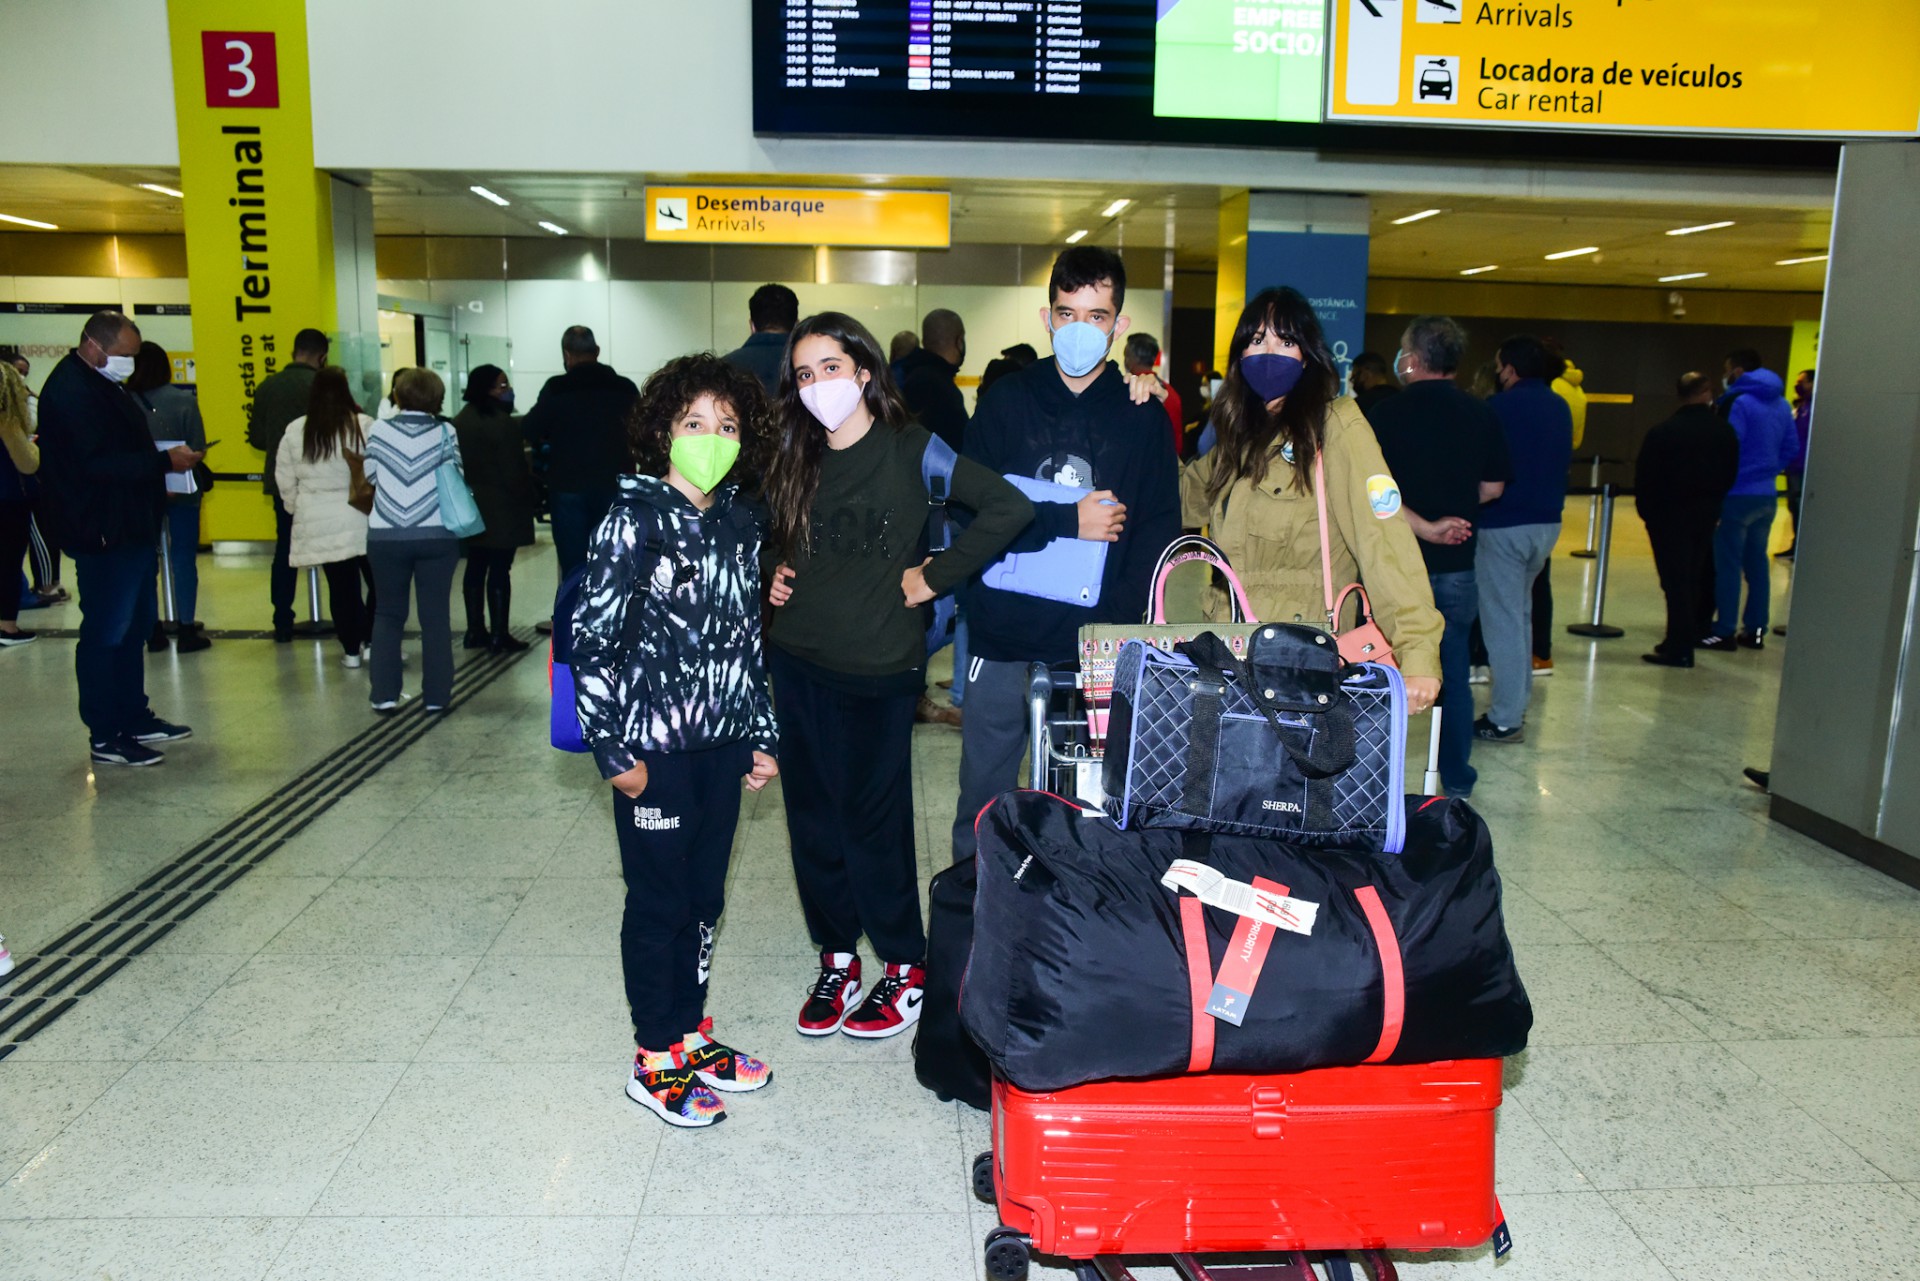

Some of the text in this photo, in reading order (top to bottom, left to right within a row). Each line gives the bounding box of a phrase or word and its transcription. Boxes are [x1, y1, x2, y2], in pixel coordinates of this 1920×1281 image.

[812, 9, 840, 18] Buenos
[840, 9, 860, 19] Aires
[1475, 2, 1573, 28] Arrivals
[812, 32, 836, 41] Lisboa
[812, 43, 836, 53] Lisboa
[812, 55, 835, 64] Dubai
[225, 40, 256, 98] 3
[812, 66, 838, 76] Cidade
[838, 66, 849, 76] do
[849, 66, 880, 77] Panamá
[1480, 57, 1744, 89] Locadora de veículos
[812, 78, 846, 87] Istambul
[1477, 87, 1603, 114] Car rental
[696, 195, 825, 217] Desembarque
[221, 125, 271, 322] Terminal
[696, 216, 765, 232] Arrivals
[241, 334, 254, 357] no
[260, 334, 276, 352] at
[239, 361, 257, 398] está
[633, 805, 663, 820] ABER
[634, 815, 681, 831] CROMBIE
[1240, 919, 1263, 962] PRIORITY
[1212, 1004, 1237, 1019] LATAM
